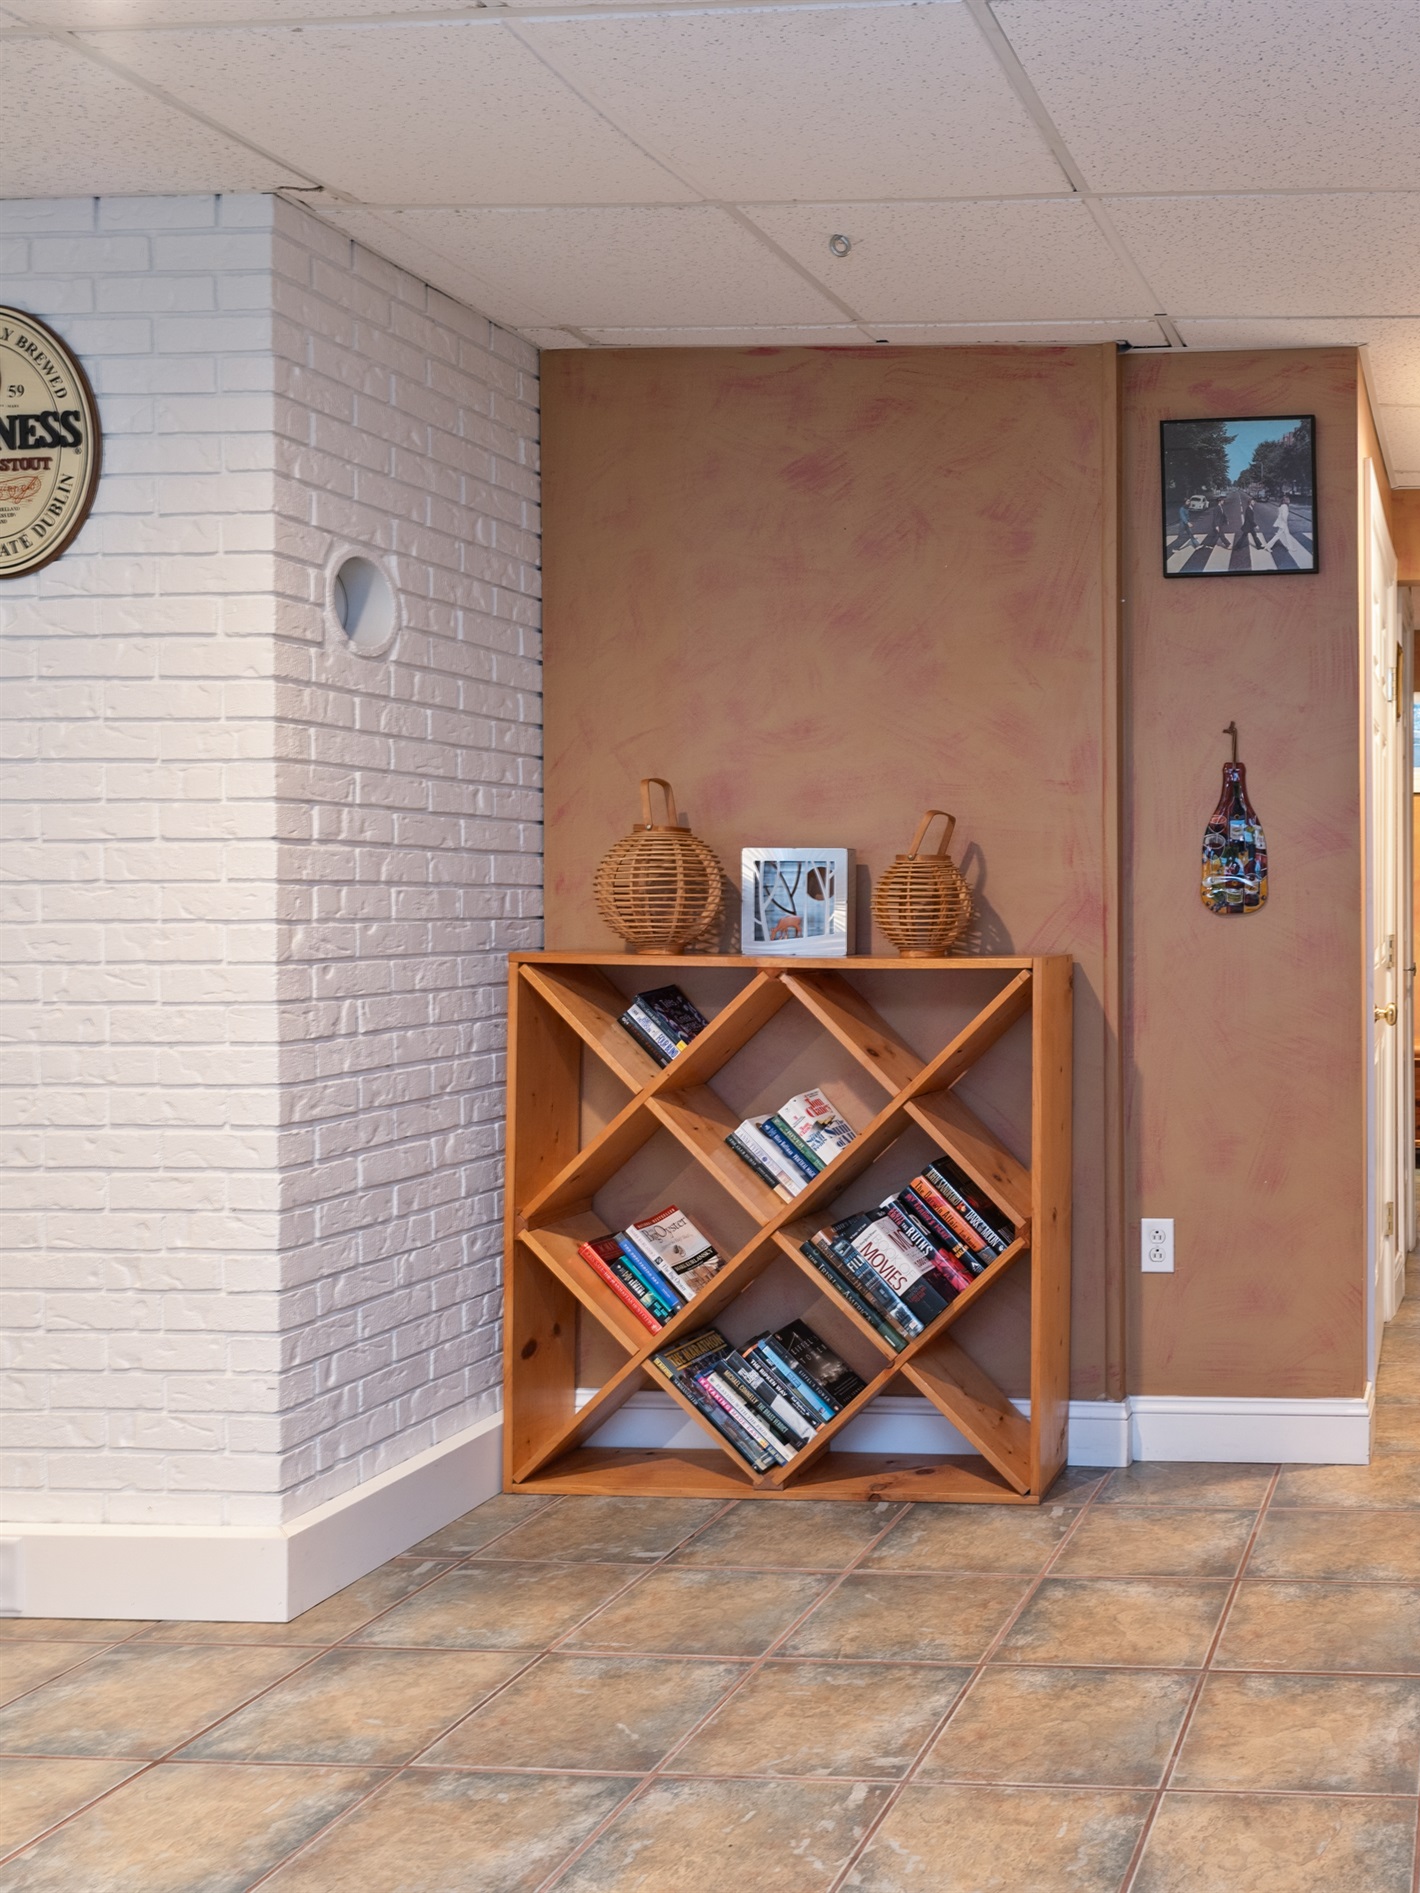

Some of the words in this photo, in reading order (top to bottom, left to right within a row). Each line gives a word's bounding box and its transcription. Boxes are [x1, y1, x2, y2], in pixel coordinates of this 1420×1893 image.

[15, 335, 68, 400] BREWED
[8, 384, 25, 398] 59
[32, 473, 74, 538] DUBLIN
[904, 1193, 915, 1204] MY
[913, 1180, 928, 1194] The
[922, 1190, 946, 1214] Darwin
[941, 1209, 961, 1230] Affair
[925, 1167, 943, 1185] JOHN
[935, 1179, 962, 1206] SANDFORD
[963, 1209, 983, 1229] DARK
[980, 1226, 1000, 1247] MOON
[653, 1216, 688, 1240] Oyster
[900, 1222, 909, 1231] THE
[903, 1226, 934, 1256] RUINS
[661, 1263, 671, 1273] The
[673, 1277, 687, 1291] Oyster
[858, 1241, 909, 1292] MOVIES
[807, 1253, 818, 1264] THE
[817, 1263, 838, 1284] IRISH
[841, 1289, 873, 1321] AMERICA
[667, 1349, 686, 1367] THE
[684, 1331, 725, 1358] MARATHON
[749, 1358, 761, 1370] THE
[758, 1367, 778, 1387] RIPKEN
[774, 1384, 787, 1397] WAY
[798, 1369, 816, 1388] EIFFEL'S
[815, 1386, 831, 1402] TOWER
[698, 1378, 731, 1411] KAYAKING
[731, 1409, 746, 1425] MADE
[746, 1425, 761, 1439] EASY
[723, 1368, 741, 1387] MICHAEL
[738, 1384, 758, 1404] CONNELLY
[756, 1401, 766, 1411] THE
[762, 1407, 776, 1422] BRASS
[772, 1417, 788, 1434] VERDICT
